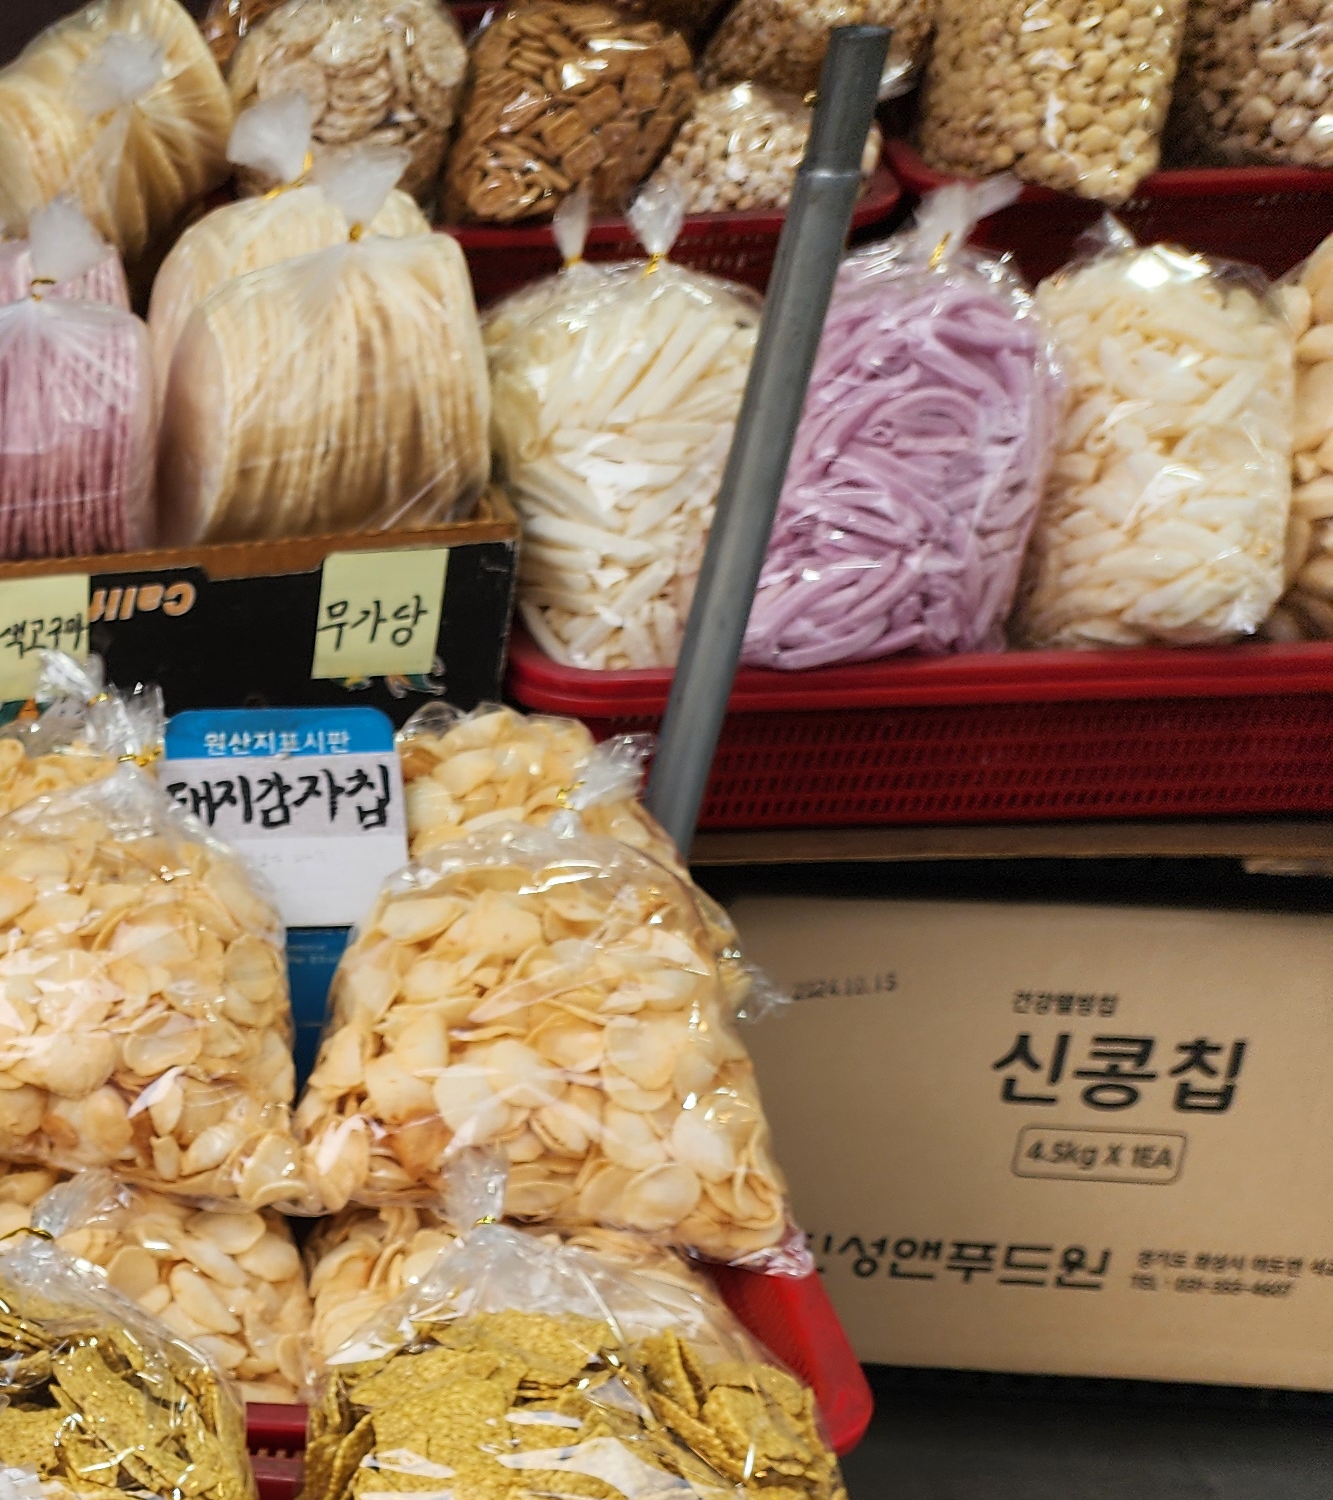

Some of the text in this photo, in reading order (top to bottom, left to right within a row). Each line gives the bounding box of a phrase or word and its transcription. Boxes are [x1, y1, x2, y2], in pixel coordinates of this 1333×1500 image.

[317, 594, 428, 651] 무가당
[204, 730, 351, 755] 원산지표시판
[992, 1031, 1247, 1112] 신콩칩
